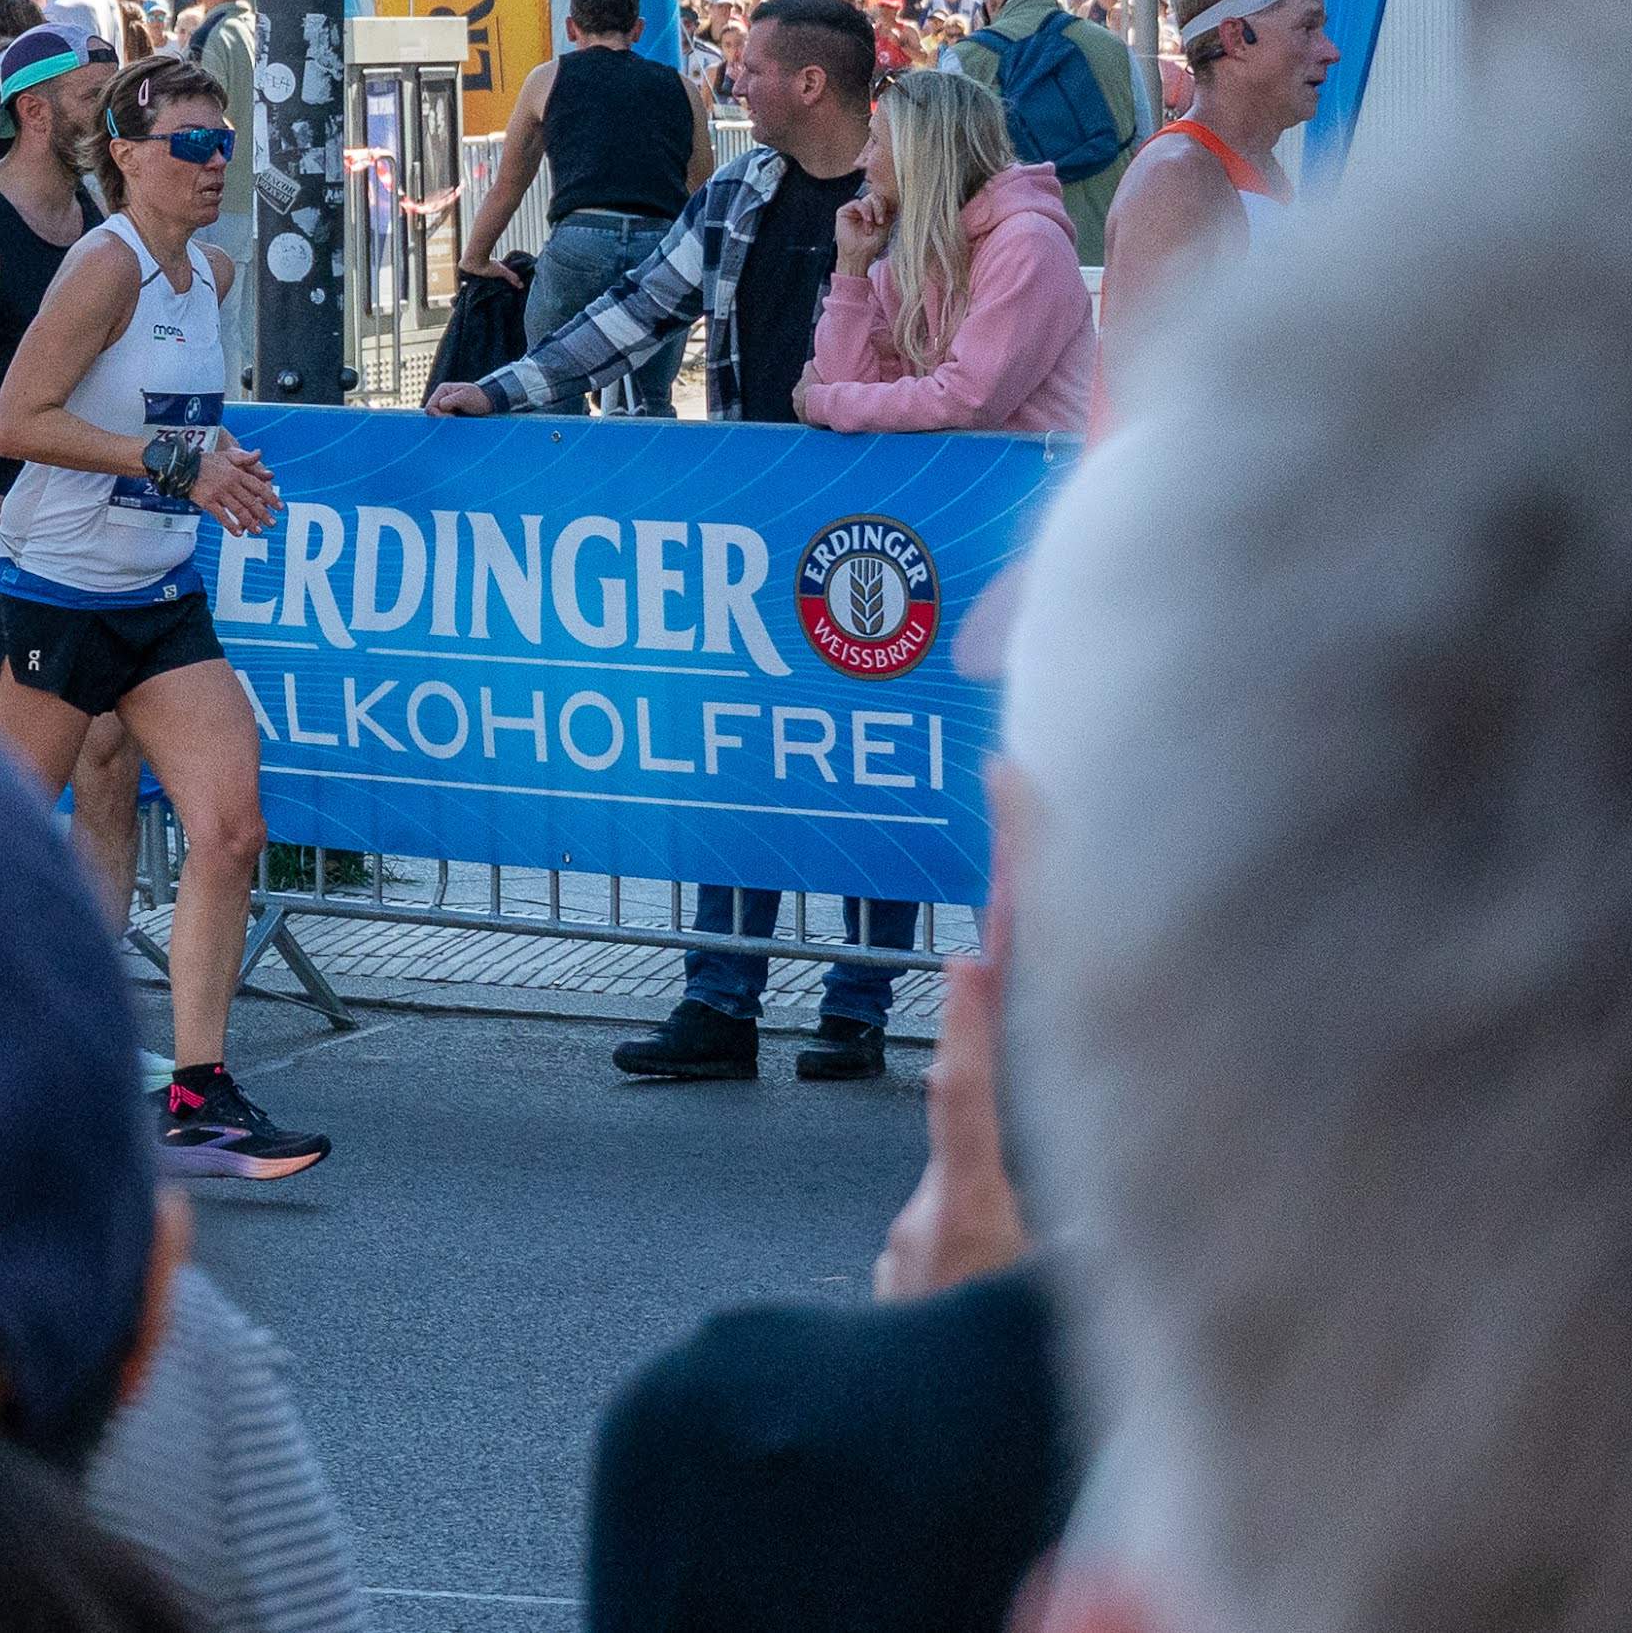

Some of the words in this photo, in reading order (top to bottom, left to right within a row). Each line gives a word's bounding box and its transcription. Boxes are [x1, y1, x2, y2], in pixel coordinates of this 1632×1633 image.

[215, 488, 793, 676] ERDINGER
[804, 525, 928, 589] ERDINGER
[814, 616, 927, 669] WEISSBRÄU
